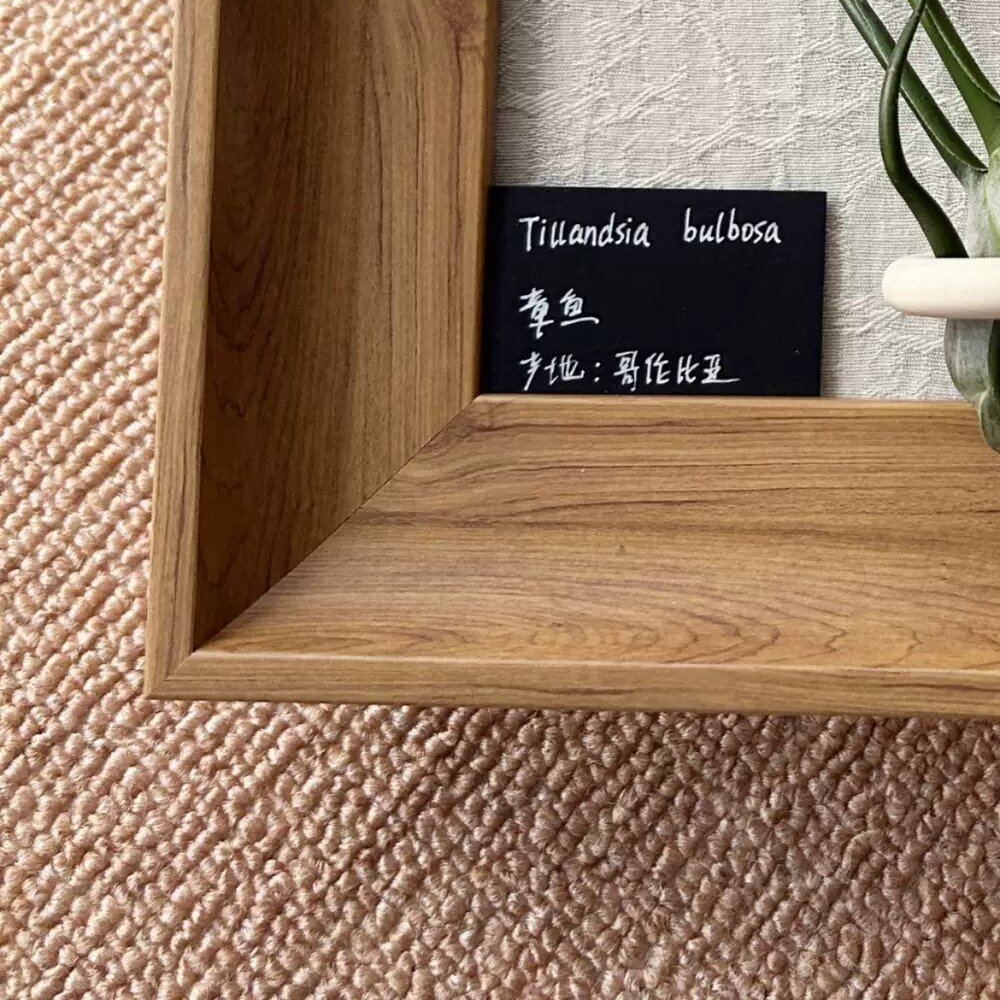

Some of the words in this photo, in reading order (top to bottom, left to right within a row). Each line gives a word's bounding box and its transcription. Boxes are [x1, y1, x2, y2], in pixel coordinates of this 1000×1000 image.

[518, 211, 651, 252] Tillandsia
[682, 206, 782, 245] bulbosa
[518, 287, 600, 340] 章鱼
